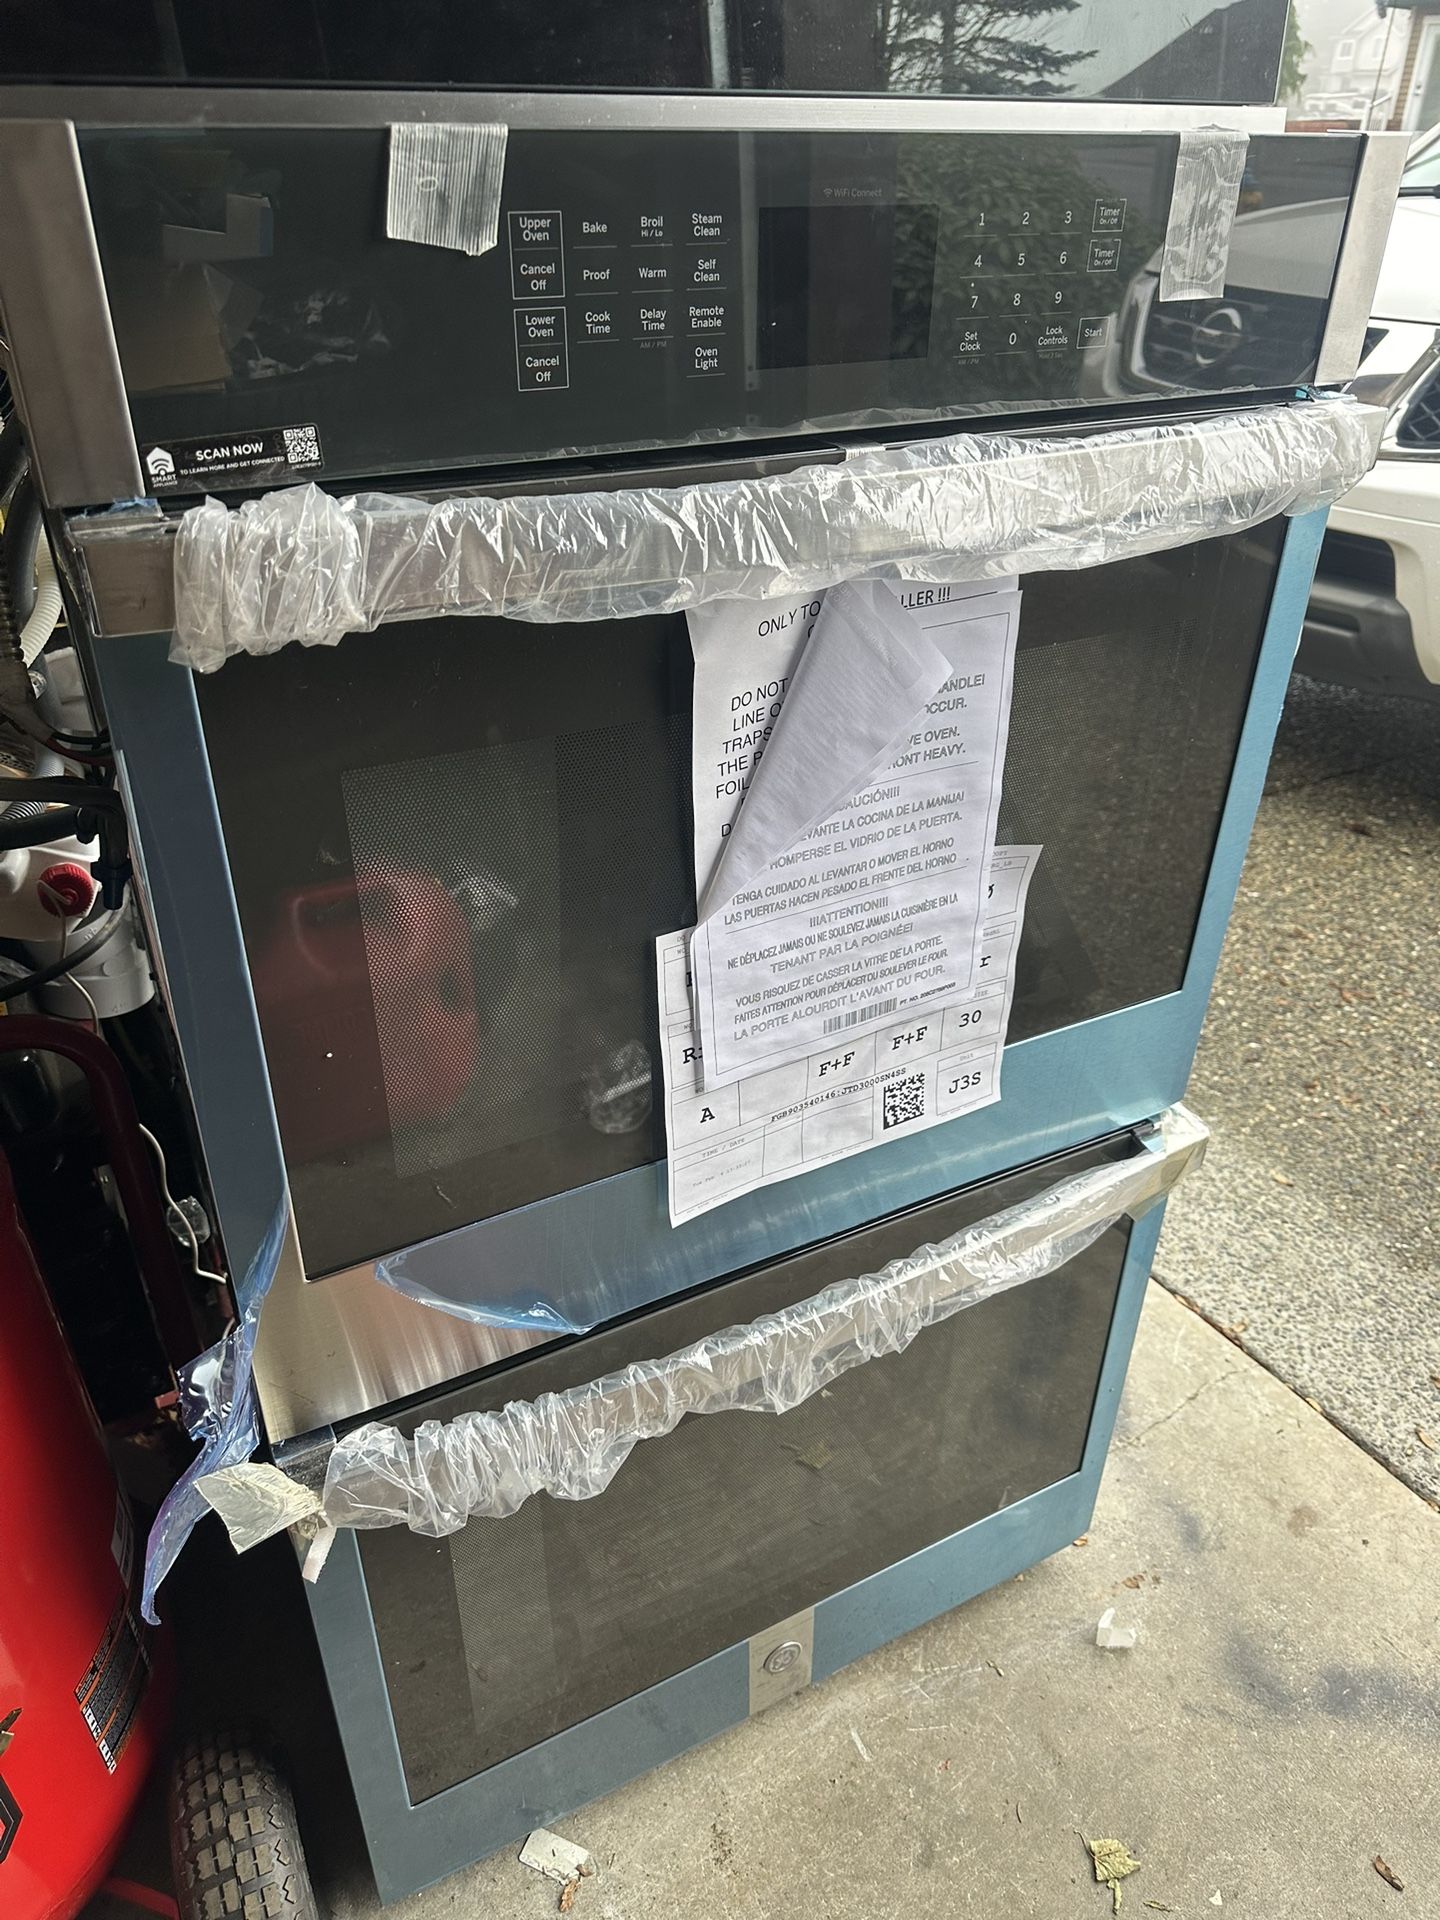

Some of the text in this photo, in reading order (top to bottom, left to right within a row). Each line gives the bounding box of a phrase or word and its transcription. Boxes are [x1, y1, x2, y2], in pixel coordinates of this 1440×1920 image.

[1100, 206, 1120, 216] Timer
[519, 217, 551, 229] Upper
[641, 216, 663, 228] Broil
[692, 214, 722, 224] Steam
[979, 213, 985, 226] 1
[1022, 212, 1030, 225] 2
[1064, 211, 1072, 224] 3
[583, 222, 607, 233] Bake
[693, 226, 720, 236] Clean
[523, 230, 549, 241] Oven
[1059, 252, 1067, 265] 6
[1094, 248, 1115, 258] Timer
[698, 260, 716, 270] Self
[974, 255, 983, 268] 4
[1017, 253, 1025, 266] 5
[520, 264, 555, 275] Cancel
[583, 270, 610, 280] Proof
[639, 267, 667, 278] Warm
[693, 271, 720, 282] Clean
[531, 280, 547, 291] Off
[971, 296, 978, 308] 7
[1013, 293, 1021, 306] 8
[1054, 292, 1062, 304] 9
[585, 312, 610, 322] Cook
[640, 309, 666, 321] Delay
[689, 307, 724, 317] Remote
[525, 315, 555, 325] Lower
[642, 321, 665, 331] Time
[691, 318, 722, 328] Enable
[528, 326, 554, 337] Oven
[586, 324, 610, 334] Time
[1046, 326, 1063, 335] Lock
[1084, 327, 1102, 338] Start
[965, 332, 978, 341] Set
[1009, 332, 1017, 345] 0
[1038, 336, 1068, 345] Controls
[695, 347, 718, 357] Oven
[960, 342, 980, 351] Clock
[525, 356, 560, 367] Cancel
[695, 359, 718, 370] Light
[536, 372, 551, 382] Off
[195, 442, 263, 461] SCAN NOW
[252, 456, 285, 465] CONNECTED
[151, 475, 177, 483] SMART
[758, 609, 797, 637] ONLY
[801, 601, 821, 620] TO
[901, 592, 934, 608] LLER
[938, 587, 951, 602] !!!
[731, 678, 788, 711] DO NOT
[733, 707, 765, 731] LINE
[723, 726, 773, 754] TRAPS
[717, 726, 960, 777] THE OVEN.
[716, 777, 750, 799] FOIL
[923, 743, 966, 761] HEAVY.
[842, 819, 854, 830] LA
[857, 808, 894, 827] COCINA
[896, 804, 910, 816] DE
[912, 801, 924, 812] LA
[834, 842, 847, 853] EL
[850, 830, 884, 848] VIDRIO
[887, 826, 901, 838] DE
[904, 822, 916, 834] LA
[919, 811, 962, 830] PUERTA.
[732, 837, 954, 906] TENGA CUIDADO AL LEVANTAR O MOVER EL HORNO
[724, 853, 956, 926] LAS PUERTAS HACEN PESADO EL FRENTE DEL HORNO
[728, 893, 958, 970] NE DÉPLACEZ JAMAIS OU NE SOULEVEZ JAMAIS LA CUISINIÈRE EN LA
[770, 952, 816, 974] TENANT
[820, 944, 842, 959] PAR
[844, 939, 858, 951] LA
[736, 992, 761, 1008] VOUS
[763, 980, 800, 1000] RISQUEZ
[802, 974, 814, 988] DE
[816, 966, 850, 983] CASSER
[852, 961, 862, 972] LA
[864, 952, 888, 968] VITRE
[890, 948, 902, 960] DE
[904, 945, 914, 956] LA
[734, 1008, 760, 1024] FAITES
[762, 994, 804, 1016] ATTENTION
[804, 988, 826, 1002] POUR
[828, 976, 864, 994] DÉPLACER
[880, 960, 917, 978] SOULEVER
[918, 956, 928, 966] LE
[734, 1028, 748, 1041] LA
[751, 1014, 788, 1036] PORTE
[792, 996, 847, 1022] ALOURDIT
[850, 980, 896, 1004] L'AVANT
[896, 974, 912, 988] DU
[914, 964, 946, 982] FOUR.
[818, 1010, 982, 1077] F+F F+F 30
[948, 1071, 982, 1094] J3S
[700, 1107, 716, 1124] A
[702, 1138, 746, 1158] TIME DATE
